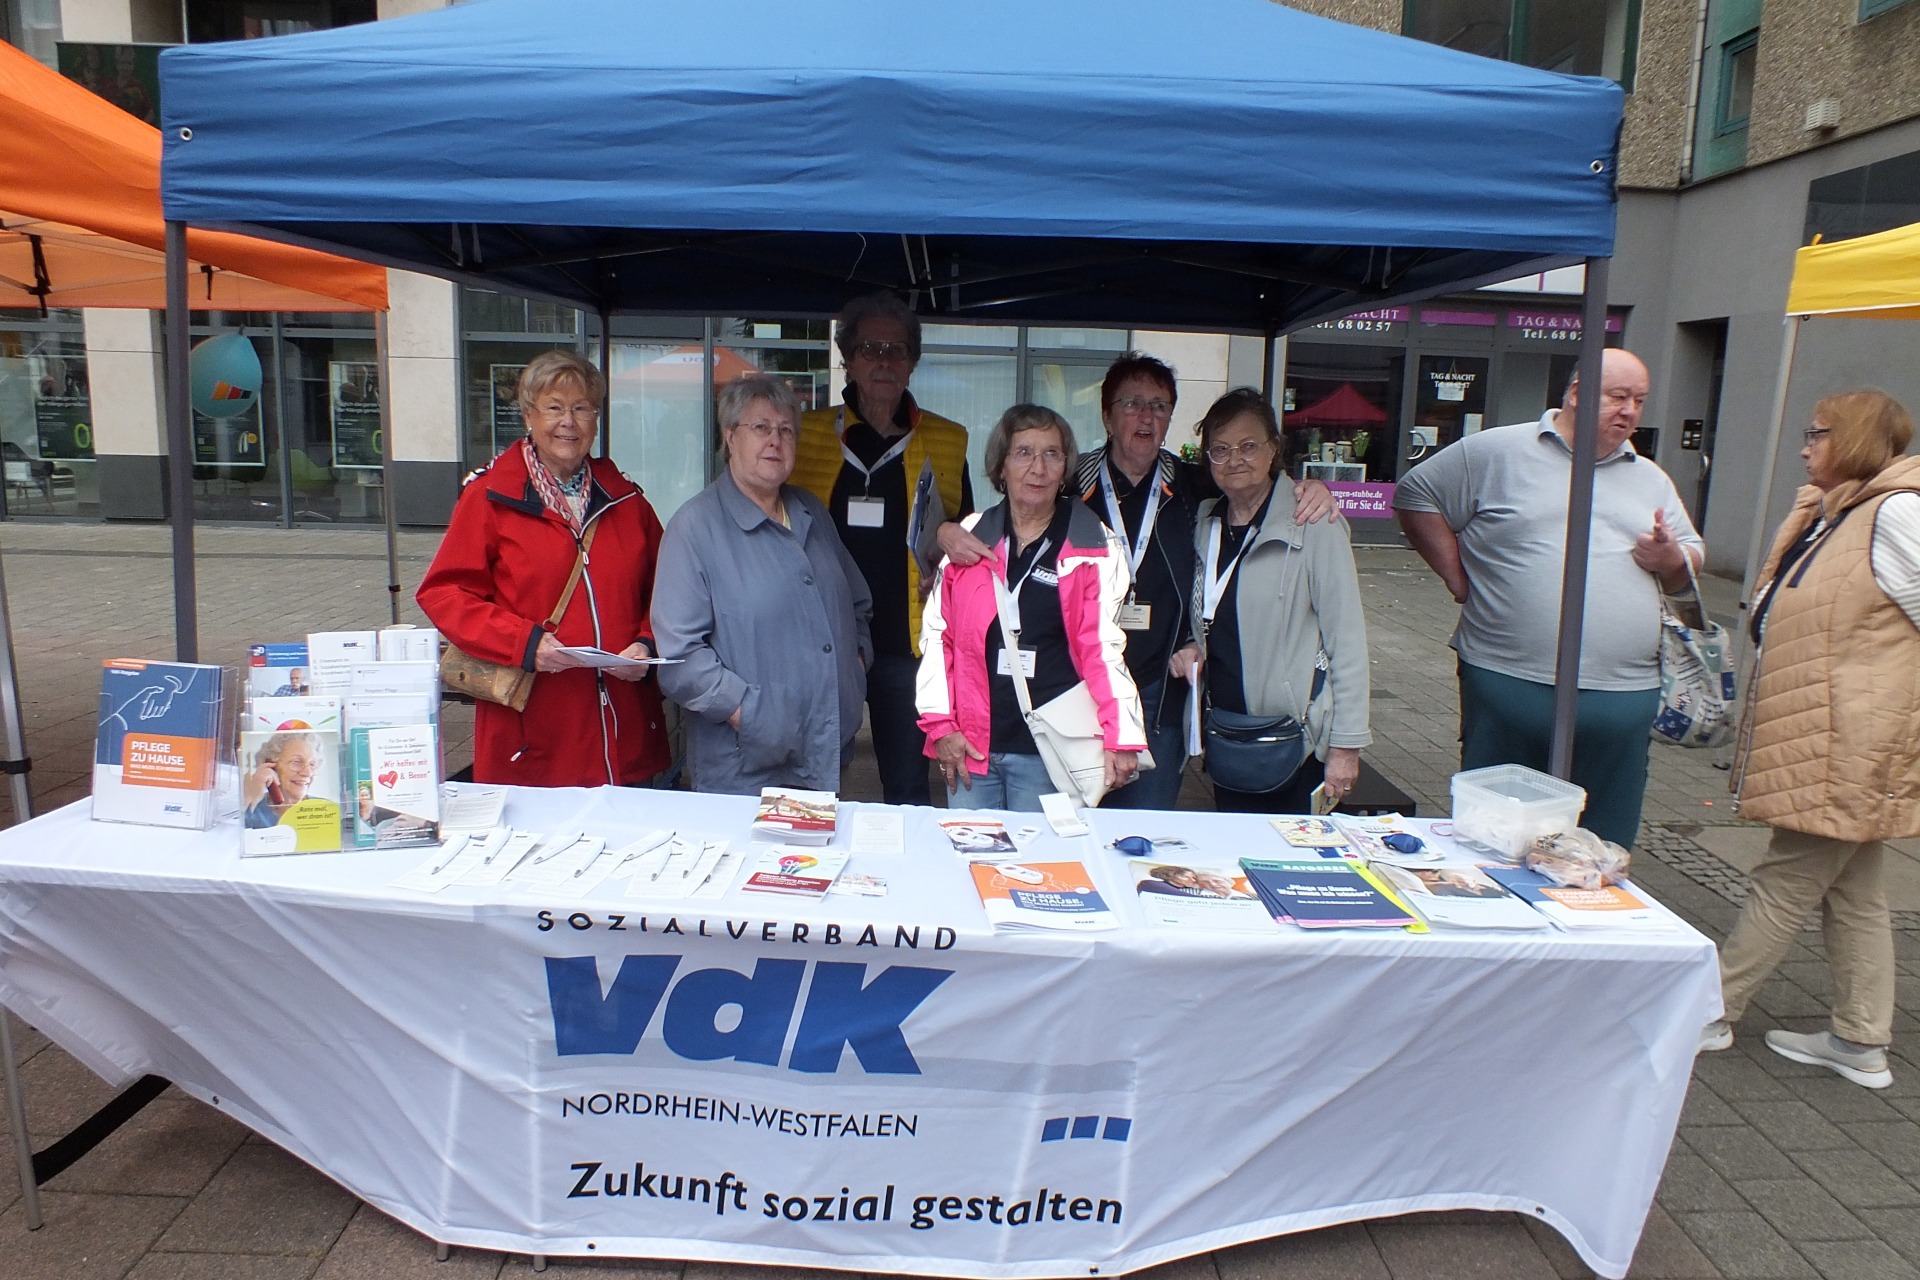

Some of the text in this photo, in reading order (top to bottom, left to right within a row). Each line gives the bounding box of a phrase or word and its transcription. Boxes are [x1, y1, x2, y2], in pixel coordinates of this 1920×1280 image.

[1311, 320, 1392, 332] el. 68 02 57
[1517, 316, 1544, 326] TAG
[1548, 317, 1558, 327] &
[1523, 328, 1547, 339] Tel.
[1551, 330, 1566, 340] 68
[1430, 372, 1444, 380] TAG
[1346, 500, 1358, 509] für
[1360, 500, 1371, 510] Sie
[1373, 501, 1386, 510] da!
[131, 740, 170, 753] PFLEGE
[130, 753, 185, 766] ZU HAUSE.
[537, 910, 957, 951] SOZIALVERBAND
[544, 954, 956, 1076] VdK
[562, 1093, 918, 1138] NORDRHEIN-WESTFALEN
[567, 1162, 1122, 1230] Zukunft sozial gestalten
